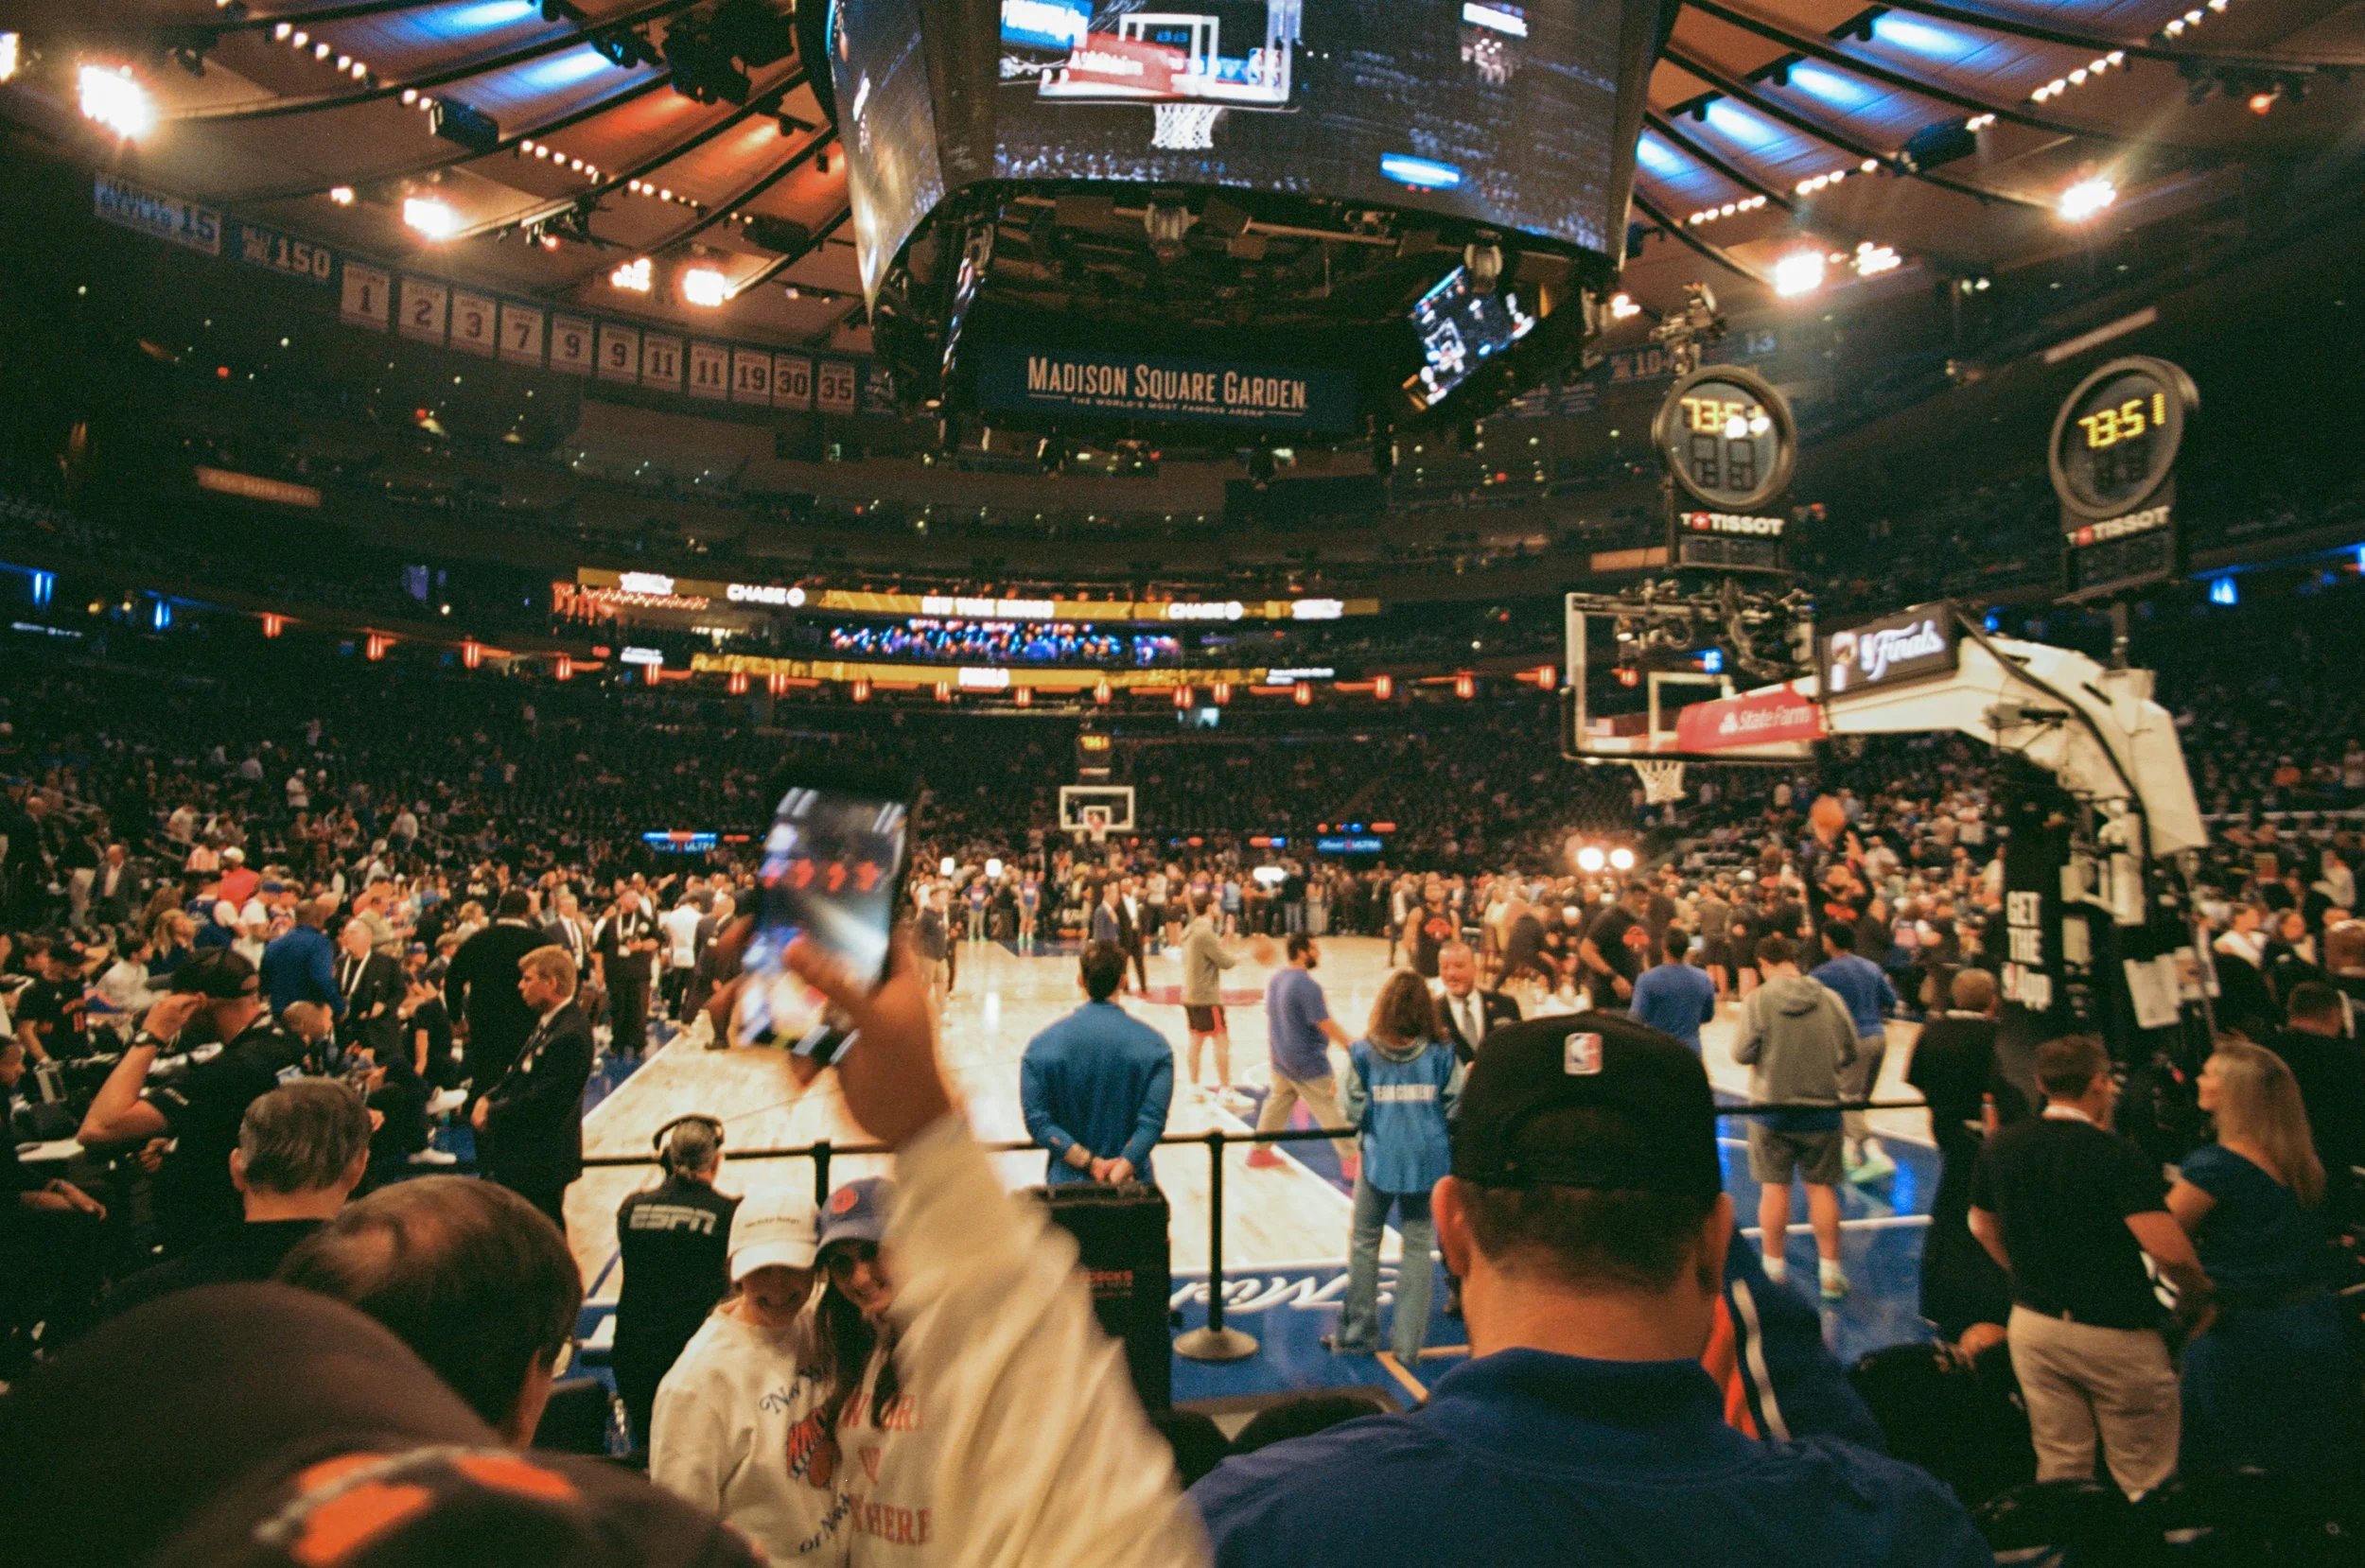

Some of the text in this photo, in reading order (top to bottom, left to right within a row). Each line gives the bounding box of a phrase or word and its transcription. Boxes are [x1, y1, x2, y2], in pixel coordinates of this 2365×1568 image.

[359, 285, 373, 314] 1
[414, 298, 433, 328] 2
[465, 311, 483, 339] 3
[515, 322, 531, 350] 7
[564, 332, 581, 360] 9
[611, 341, 626, 368] 9
[650, 349, 674, 377] 11
[696, 358, 720, 386] 11
[742, 362, 767, 391] 19
[778, 368, 808, 397] 30
[822, 371, 852, 400] 35
[1028, 357, 1307, 409] MADISON SQUARE GARDEN
[1709, 513, 1786, 536] TISSOT
[2093, 504, 2171, 542] TISSOT
[628, 1204, 717, 1235] ESPN
